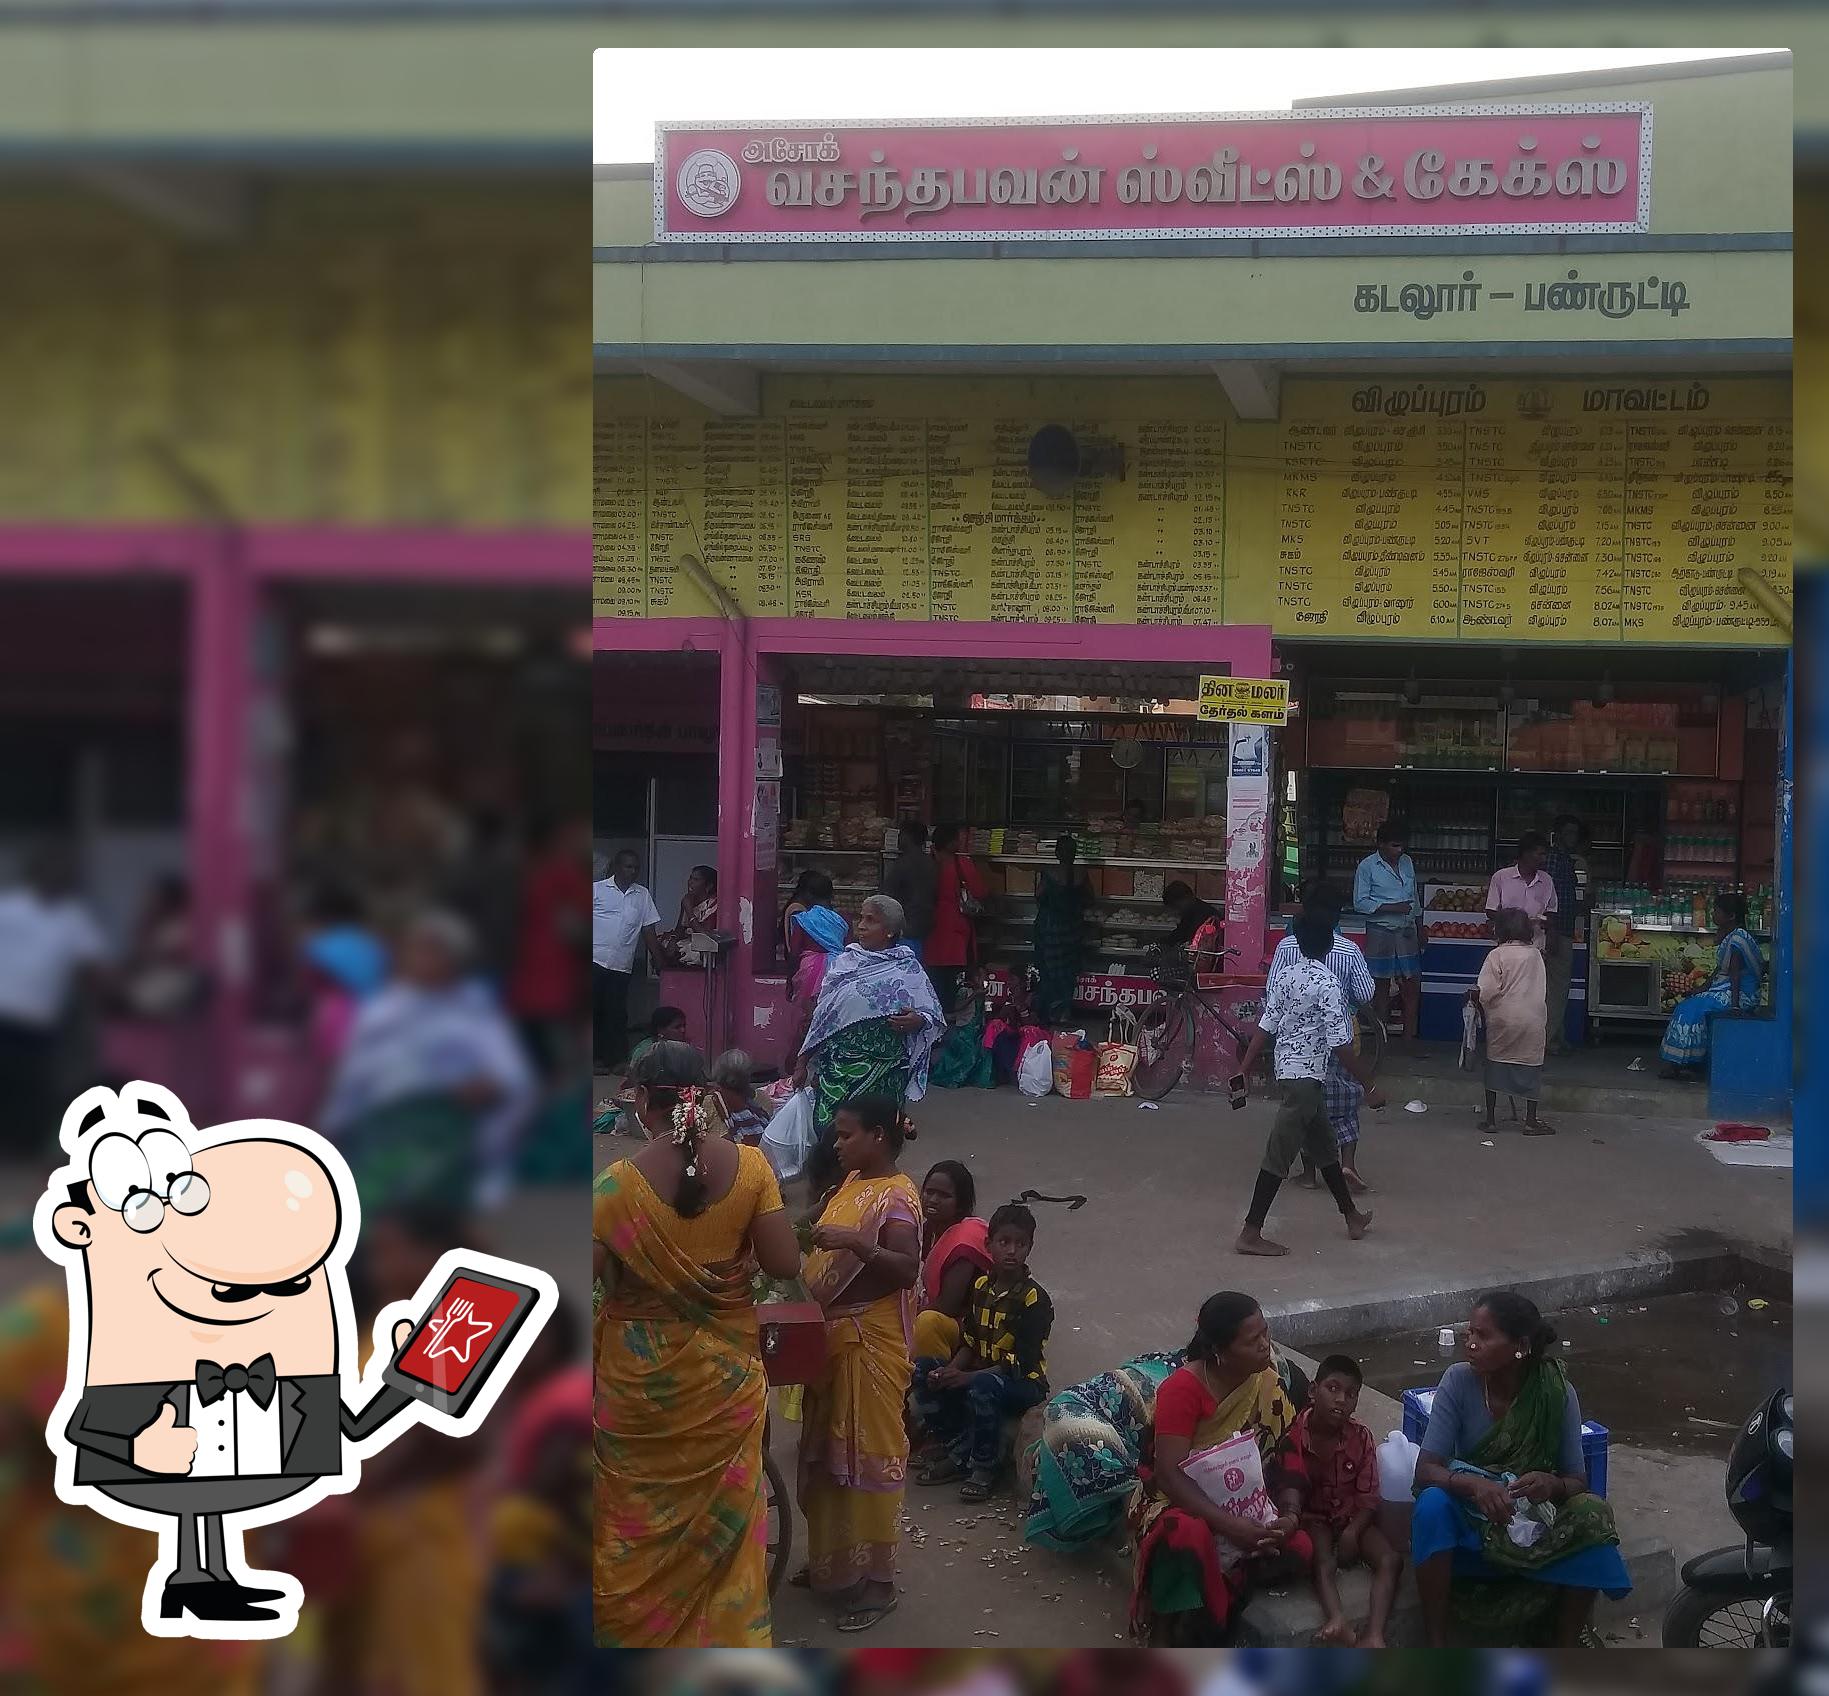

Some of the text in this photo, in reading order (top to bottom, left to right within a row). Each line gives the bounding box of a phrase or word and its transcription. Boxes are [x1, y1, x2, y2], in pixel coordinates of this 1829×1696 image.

[741, 132, 840, 163] அசோக்
[765, 134, 1629, 222] வசந்தபவன் ஸ்வீட்ஸ் & கேக்ஸ்
[1353, 269, 1482, 320] கடலூர்
[1524, 268, 1690, 319] பண்ருட்டி
[1352, 381, 1711, 418] விழுப்புரம் மாவட்டம்
[1281, 441, 1322, 451] TNSTC
[1281, 503, 1315, 513] TNSTC
[1466, 504, 1495, 514] TNSTC
[1626, 505, 1655, 516] MKMS
[1281, 519, 1312, 529] TNSTC
[1464, 520, 1494, 530] TNSTC
[1625, 520, 1653, 531] TNSTC
[1281, 534, 1304, 545] MKS
[1625, 536, 1652, 548] TNSTC
[1462, 551, 1496, 562] TNSTC
[1625, 552, 1653, 564] TNSTC
[1279, 566, 1313, 576] TNSTC
[1624, 569, 1651, 579] TNSTC
[1278, 581, 1313, 592] TNSTC
[1462, 584, 1494, 594] TNSTC
[1623, 585, 1652, 596] TNSTC
[1277, 596, 1312, 607] TNSTC
[1462, 599, 1495, 610] TNSTC
[1624, 601, 1652, 612] TNSTC
[1624, 617, 1645, 628] MKS
[1199, 703, 1285, 720] தேர்தல் களம்
